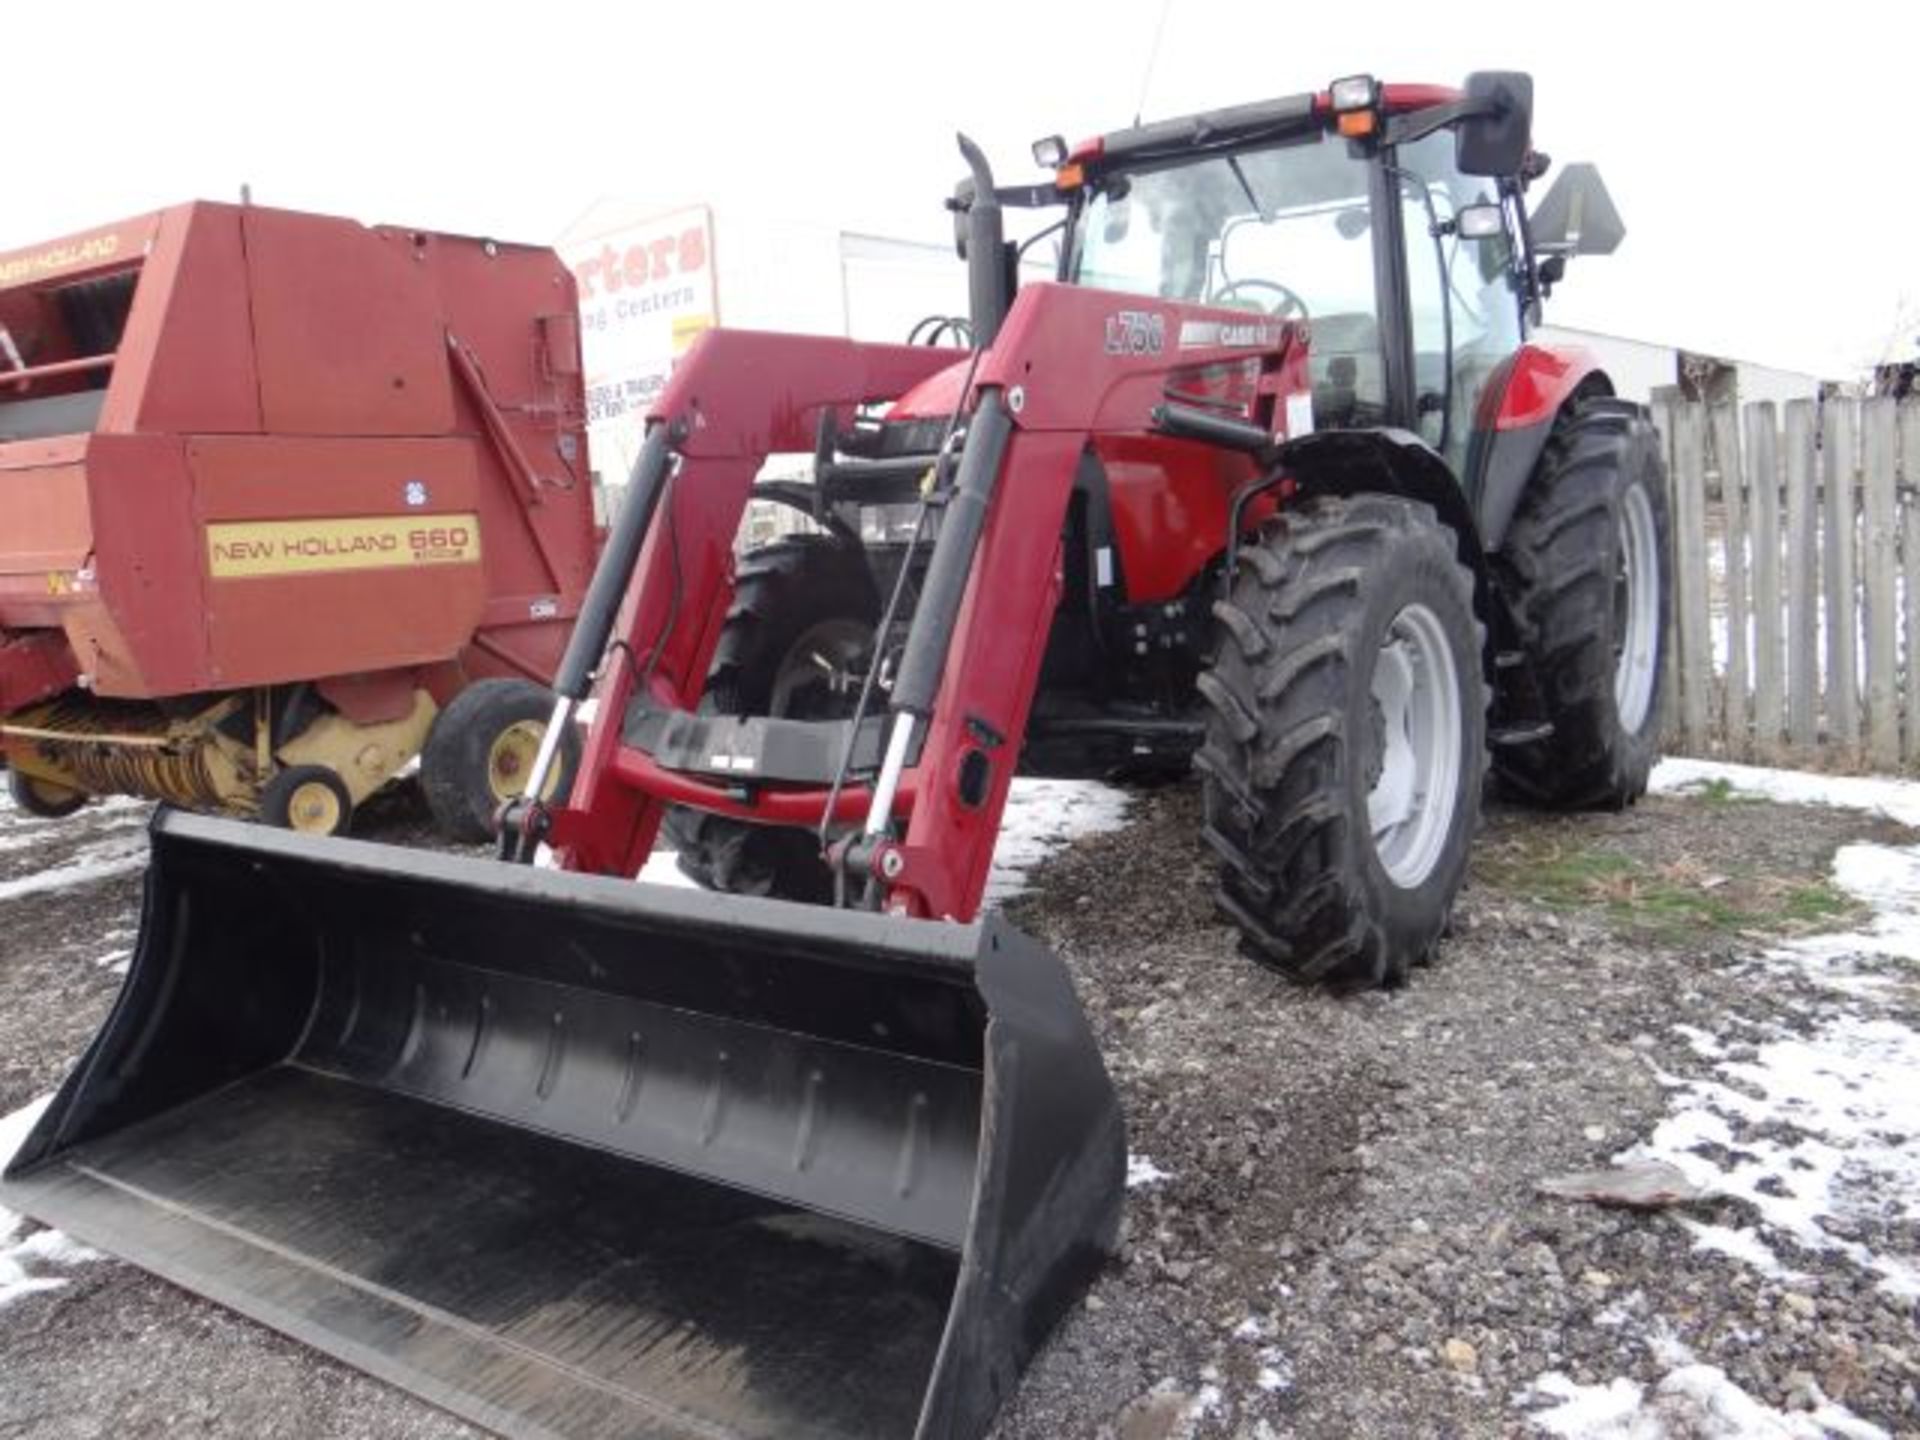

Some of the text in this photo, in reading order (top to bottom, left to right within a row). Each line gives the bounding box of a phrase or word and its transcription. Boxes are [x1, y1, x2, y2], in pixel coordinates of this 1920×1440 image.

[37, 234, 118, 268] HOLLAND
[214, 542, 274, 561] NEW
[282, 534, 397, 557] HOLLAND
[407, 527, 469, 549] 660
